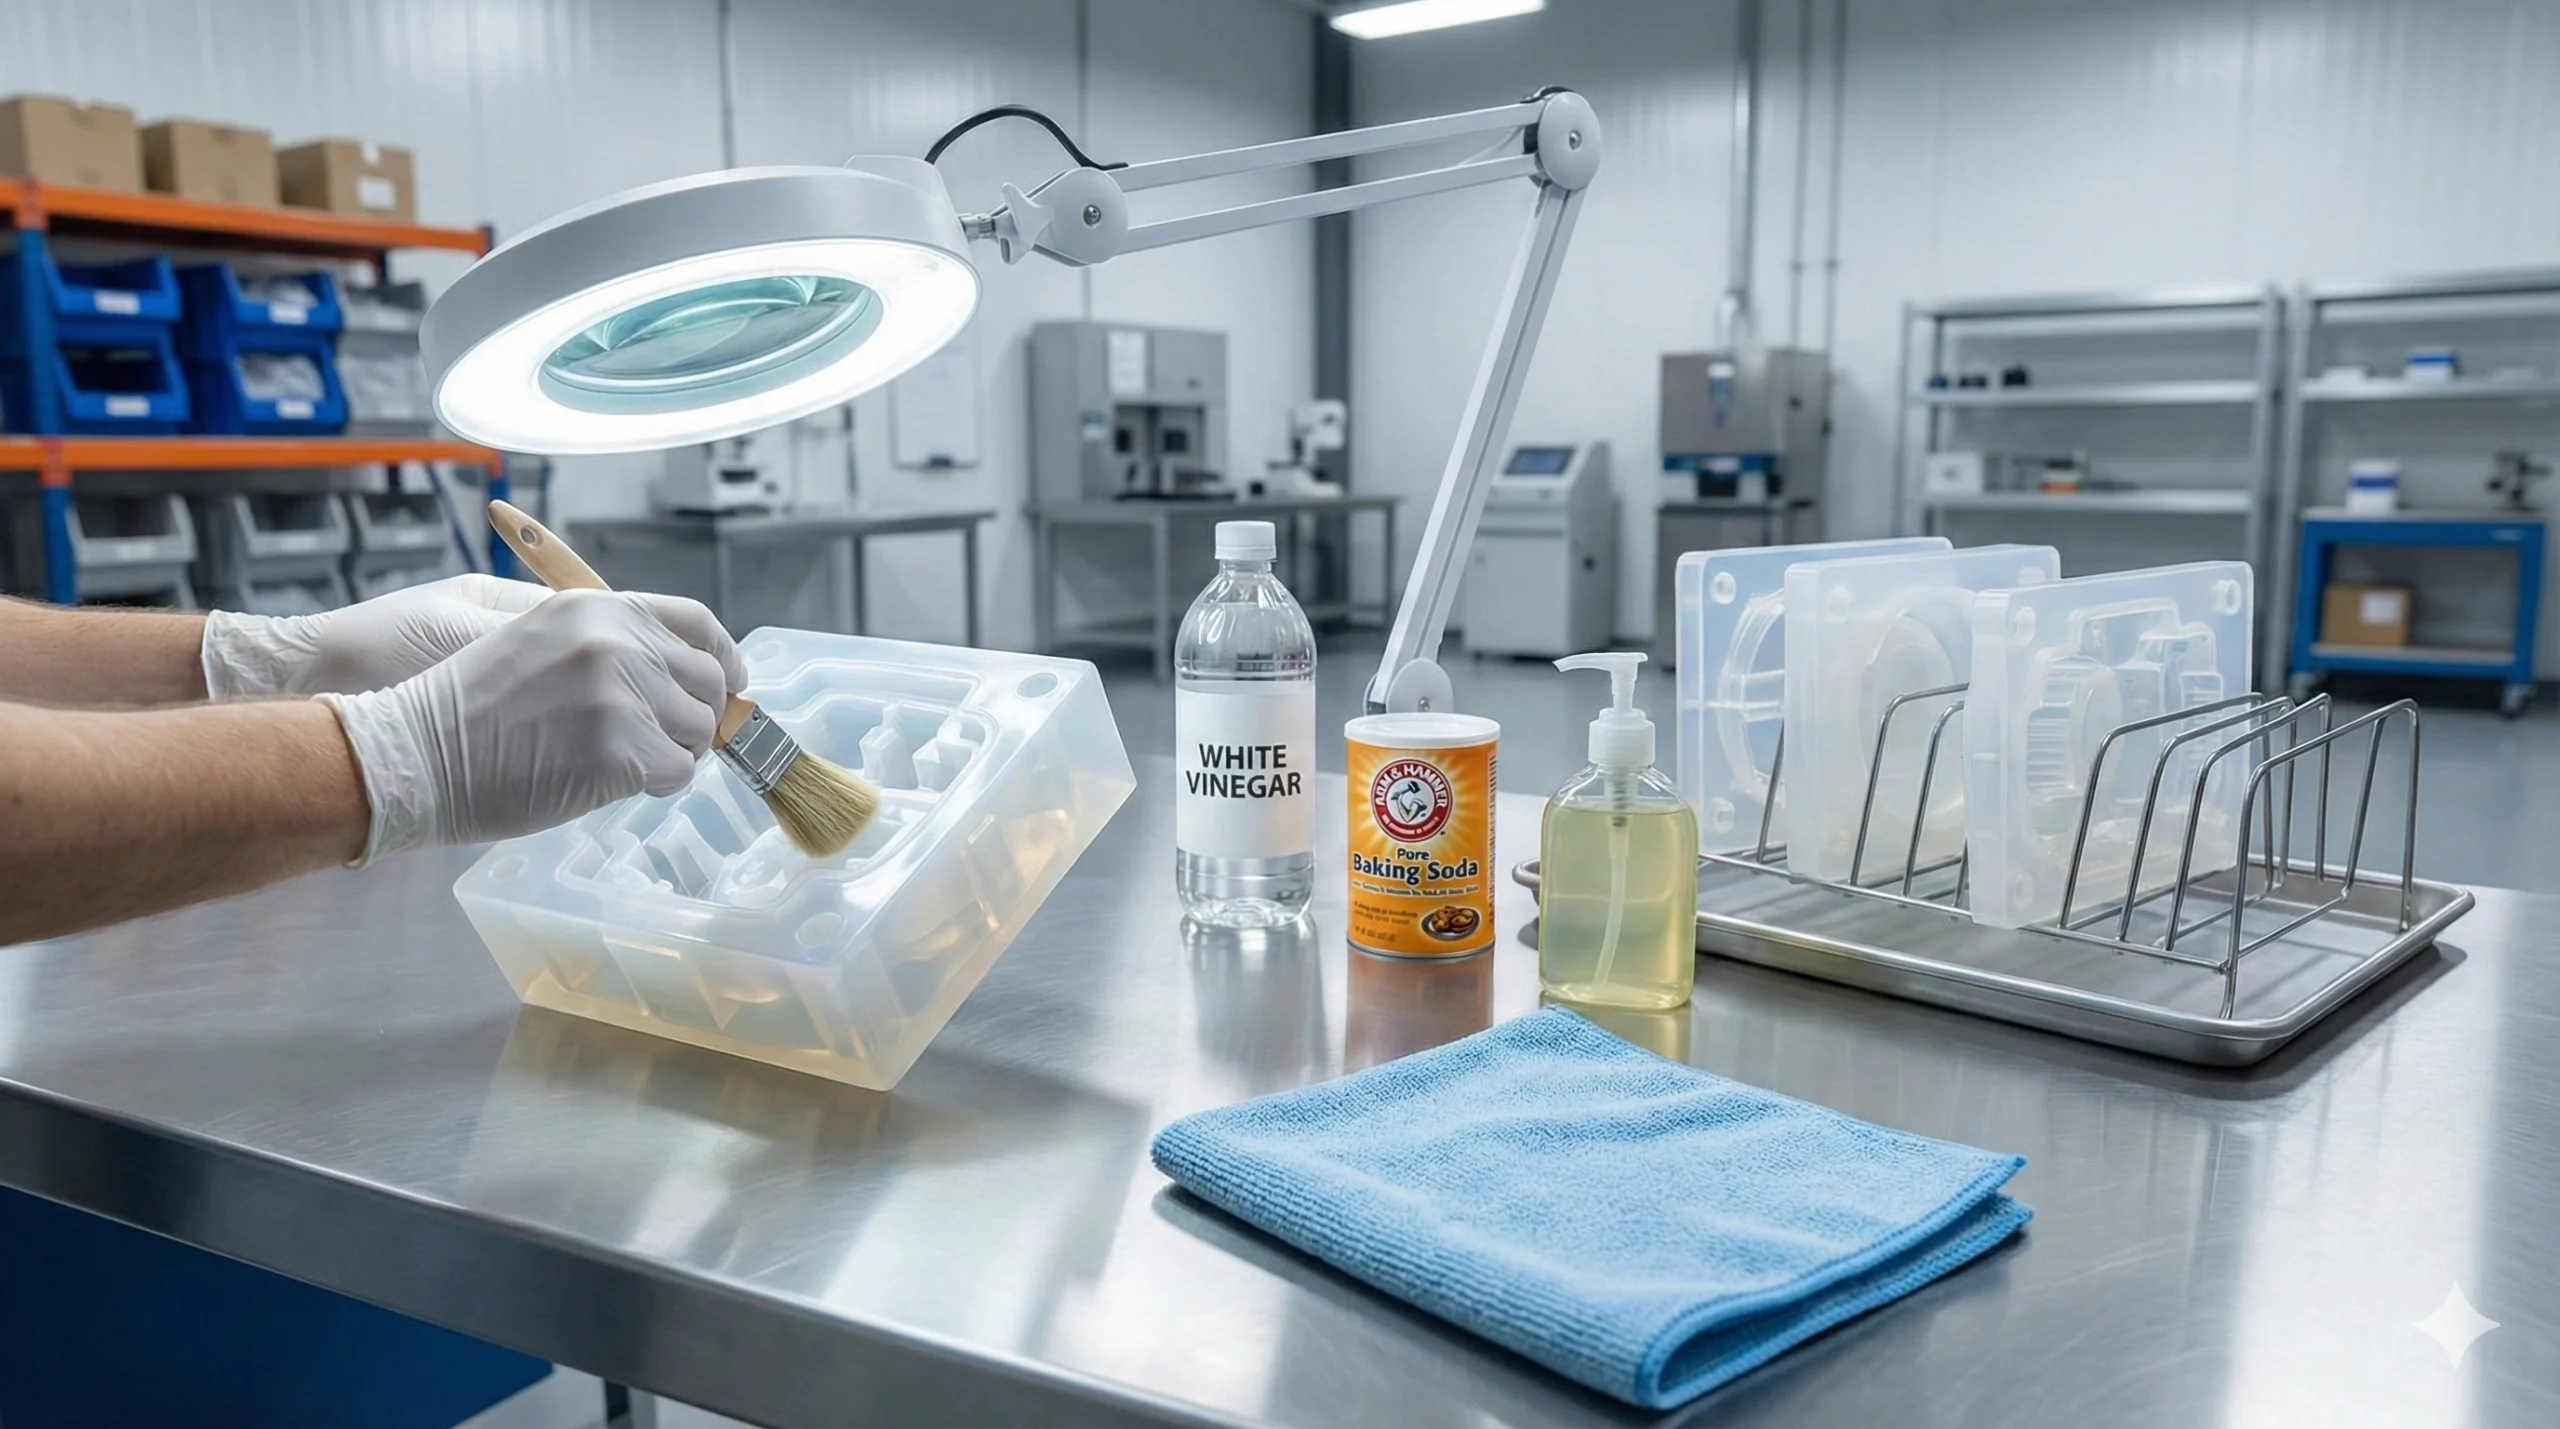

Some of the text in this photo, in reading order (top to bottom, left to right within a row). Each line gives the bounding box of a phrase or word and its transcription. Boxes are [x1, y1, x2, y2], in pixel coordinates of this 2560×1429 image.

[1199, 743, 1287, 770] WHITE
[1186, 770, 1301, 798] VINEGAR
[1390, 767, 1403, 780] &
[1403, 764, 1447, 808] HAMMER
[1353, 853, 1478, 885] Baking Soda
